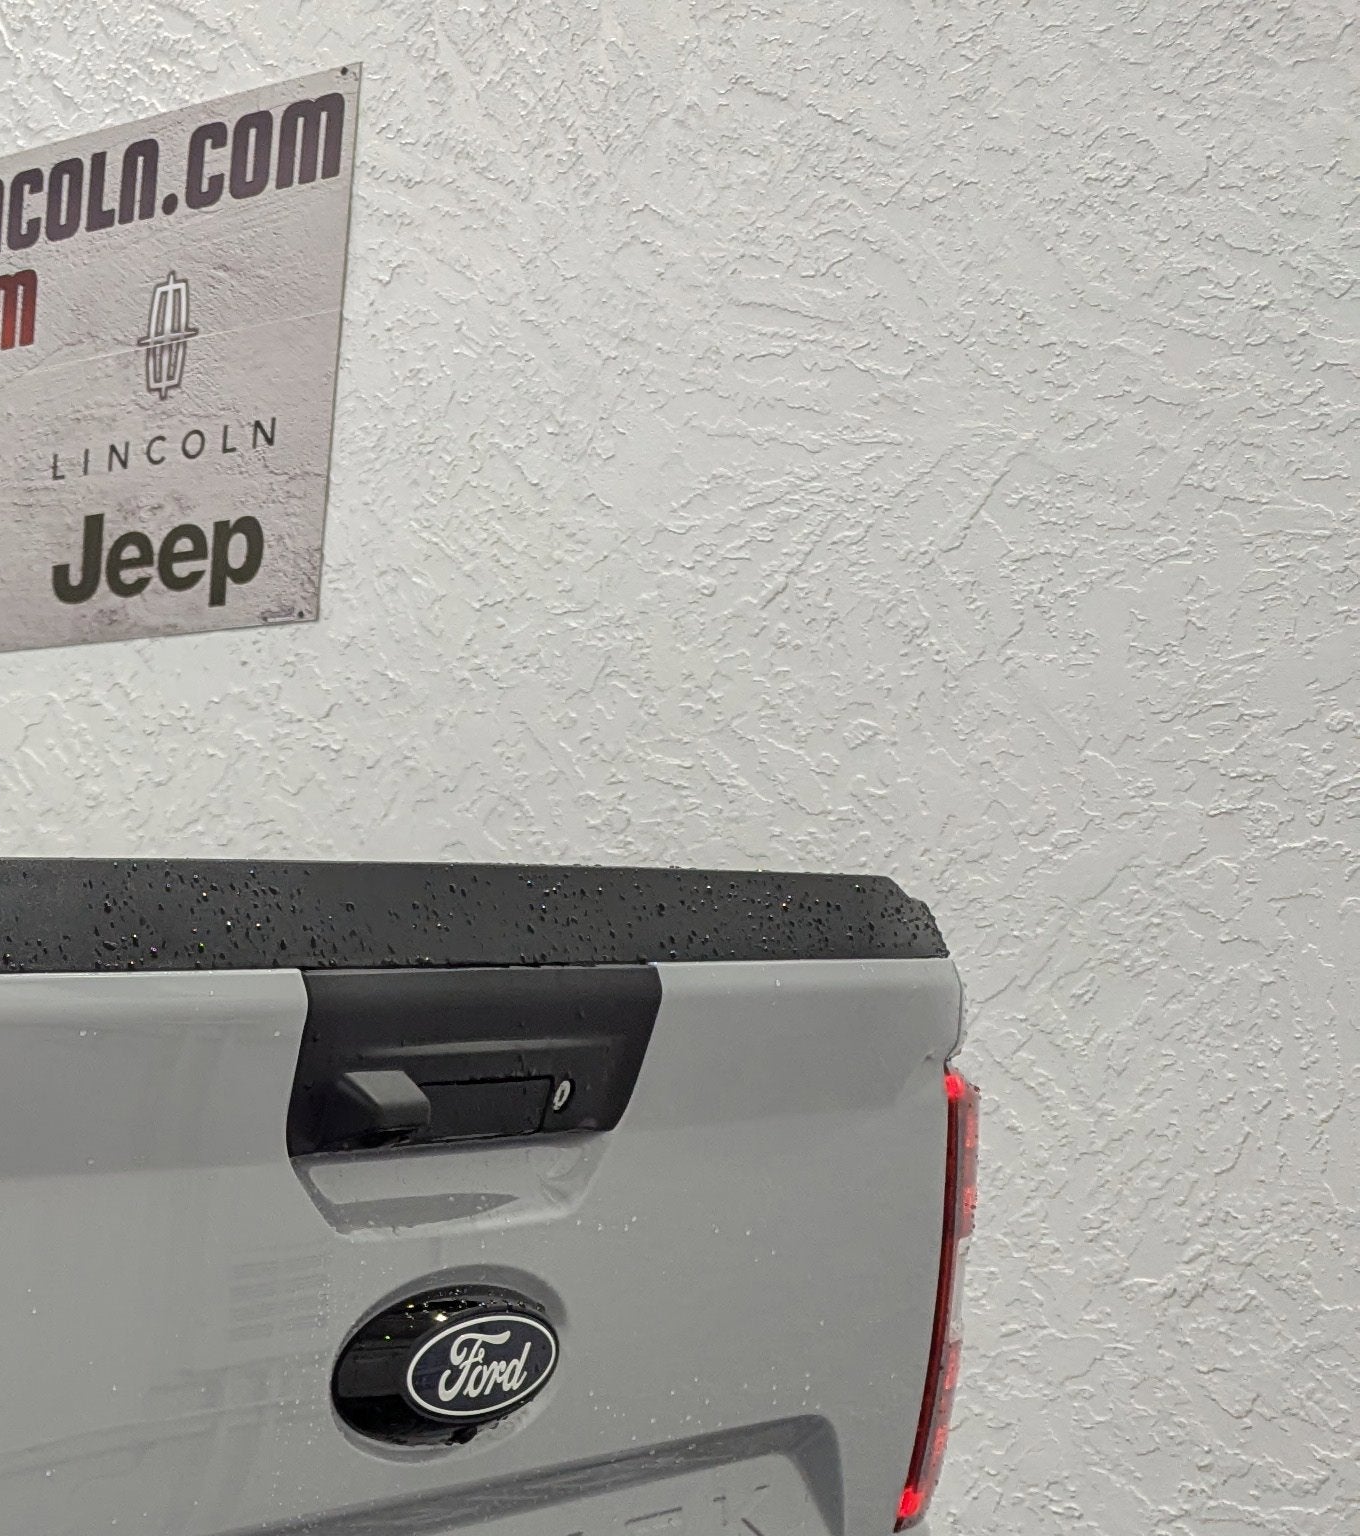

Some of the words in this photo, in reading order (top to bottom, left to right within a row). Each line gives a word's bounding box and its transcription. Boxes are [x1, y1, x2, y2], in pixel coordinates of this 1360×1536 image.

[52, 418, 276, 482] LINCOLN
[52, 515, 264, 607] Jeep
[438, 1330, 532, 1402] Ford
